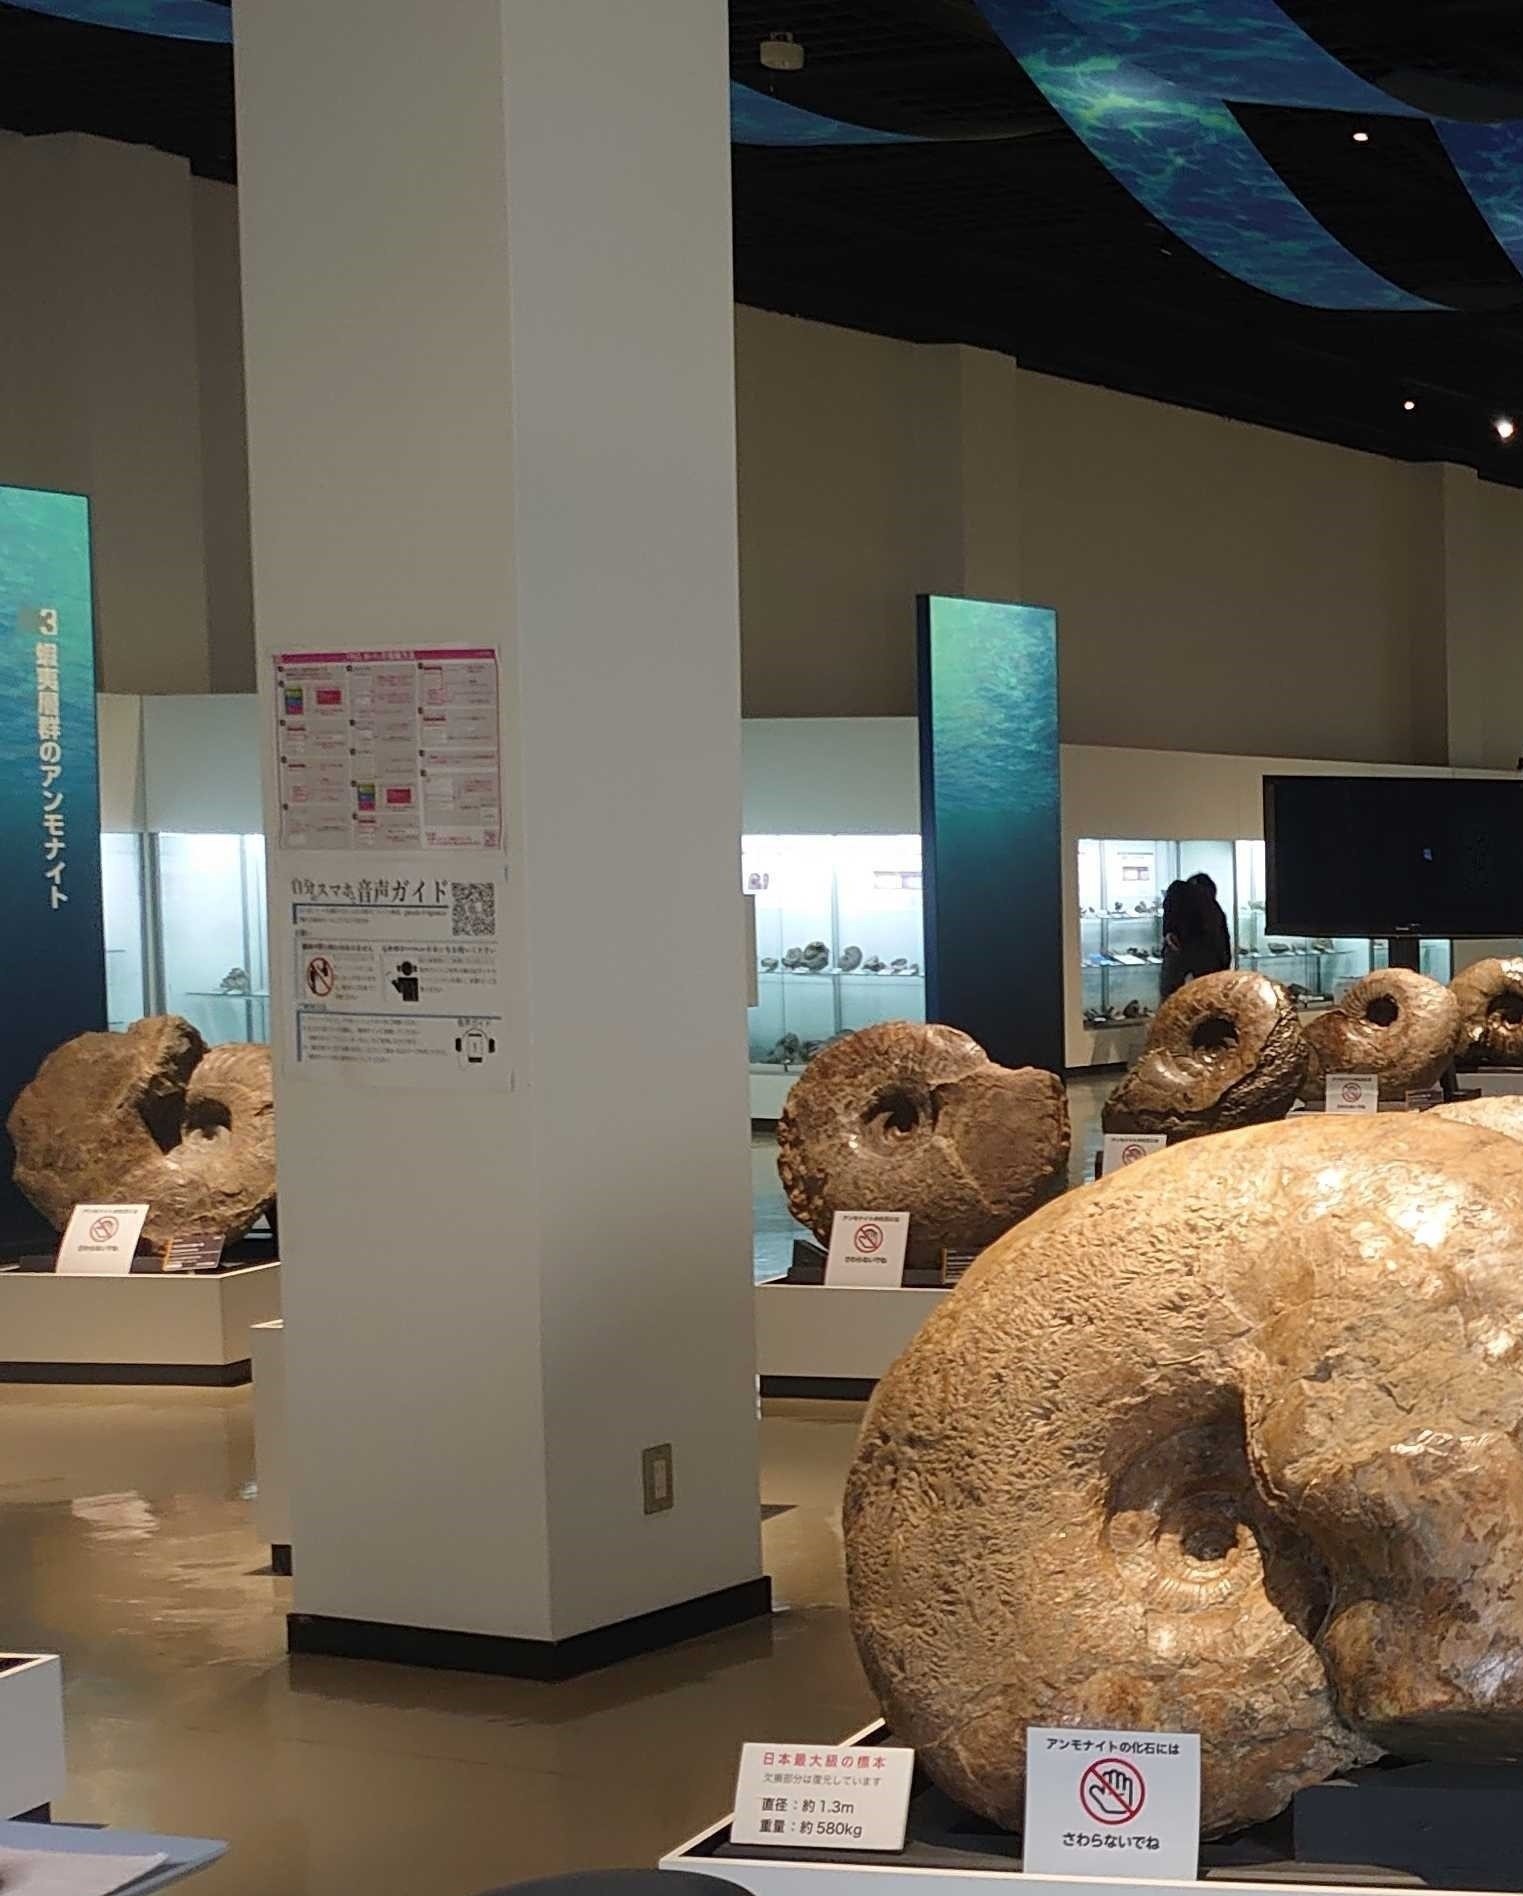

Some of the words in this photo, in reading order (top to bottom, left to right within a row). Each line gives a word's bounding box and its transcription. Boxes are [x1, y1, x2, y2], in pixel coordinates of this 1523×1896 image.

[39, 608, 58, 635] 3
[1046, 1737, 1180, 1755] アンモナイトの化石には
[763, 1751, 887, 1769] 日本最大級の標本
[1062, 1832, 1160, 1850] さわらないでね
